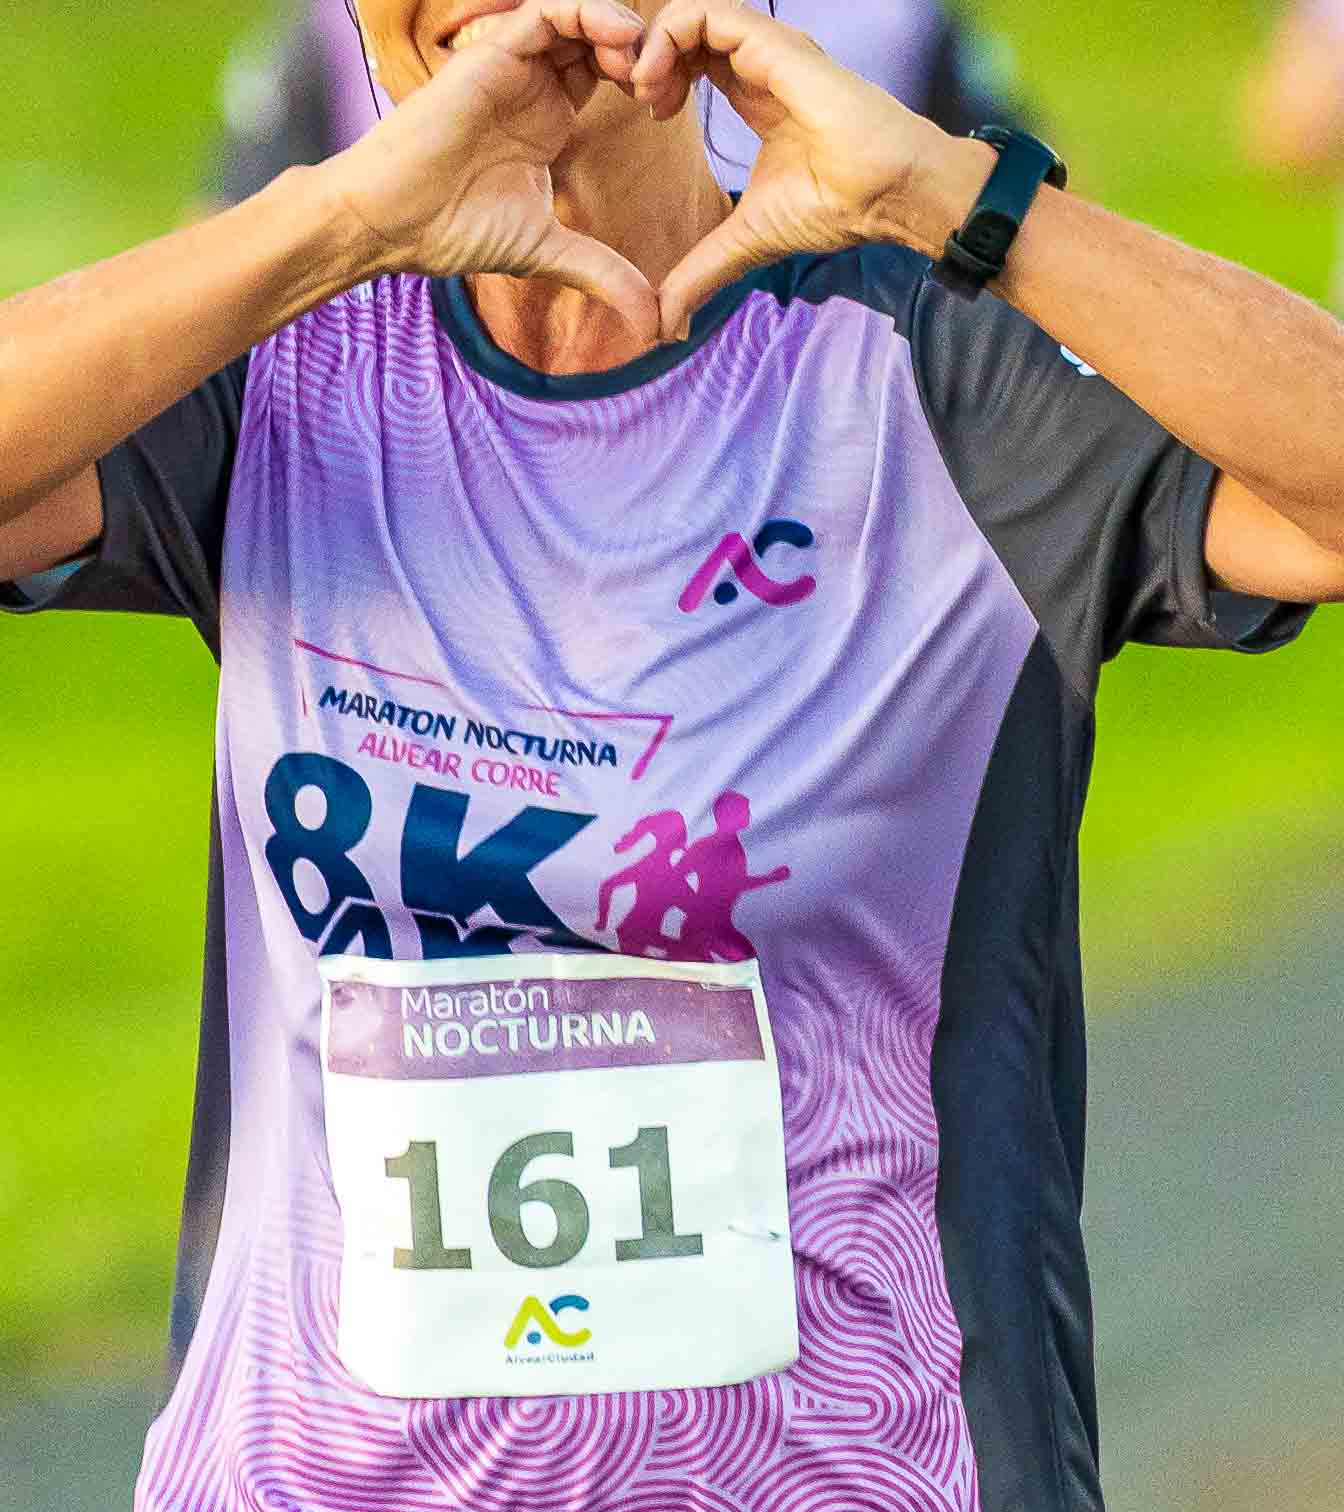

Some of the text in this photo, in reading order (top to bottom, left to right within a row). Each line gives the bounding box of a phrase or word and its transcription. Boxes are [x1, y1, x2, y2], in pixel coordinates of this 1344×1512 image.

[319, 685, 617, 768] MARATON NOCTURNA
[358, 732, 562, 798] ALVEAR CORRE
[264, 752, 598, 943] 8K
[402, 978, 549, 1019] Maratón
[403, 1009, 656, 1057] NOCTURNA
[384, 1125, 704, 1270] 161
